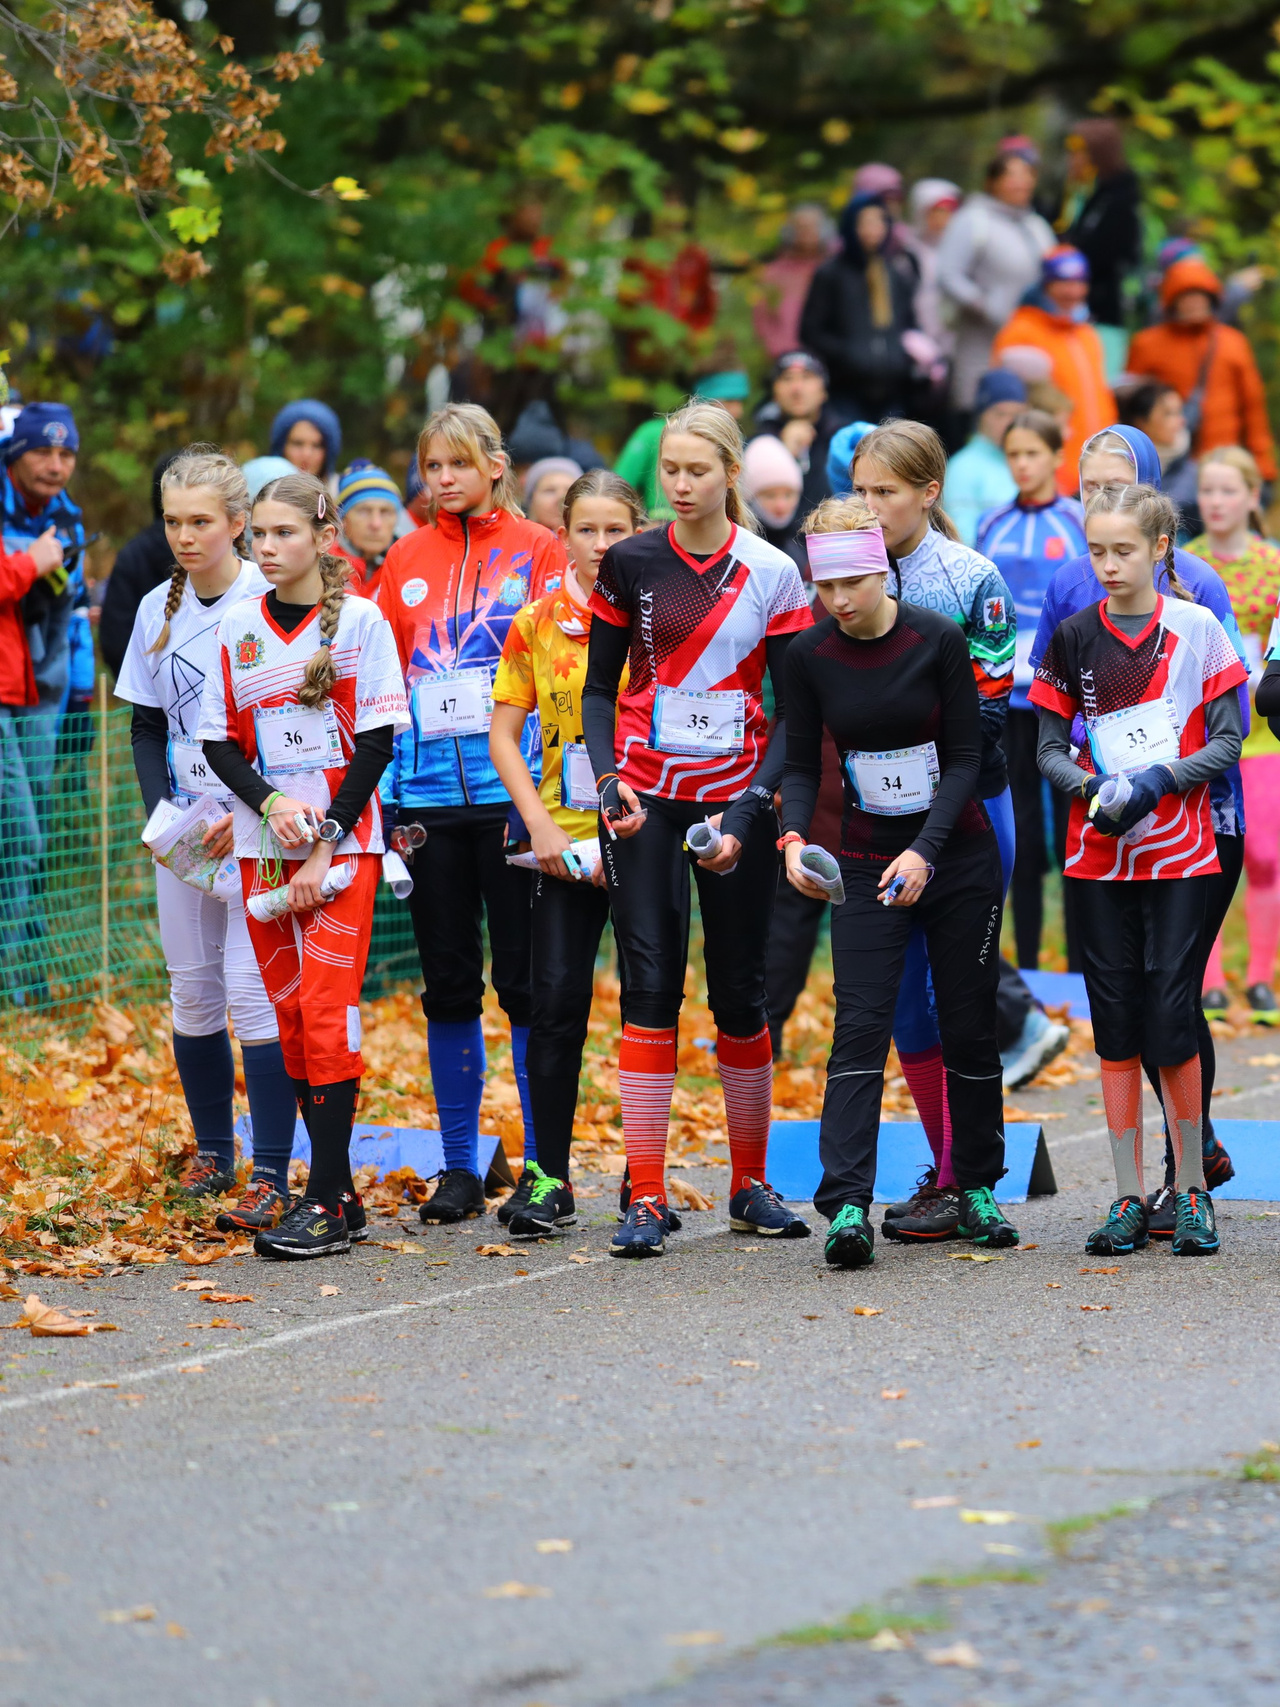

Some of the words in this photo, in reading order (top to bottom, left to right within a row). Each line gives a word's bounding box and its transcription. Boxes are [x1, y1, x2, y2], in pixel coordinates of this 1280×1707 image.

[440, 698, 456, 713] 47
[687, 714, 709, 730] 35
[283, 729, 303, 748] 36
[1126, 728, 1147, 748] 33
[190, 763, 206, 778] 48
[881, 775, 902, 791] 34
